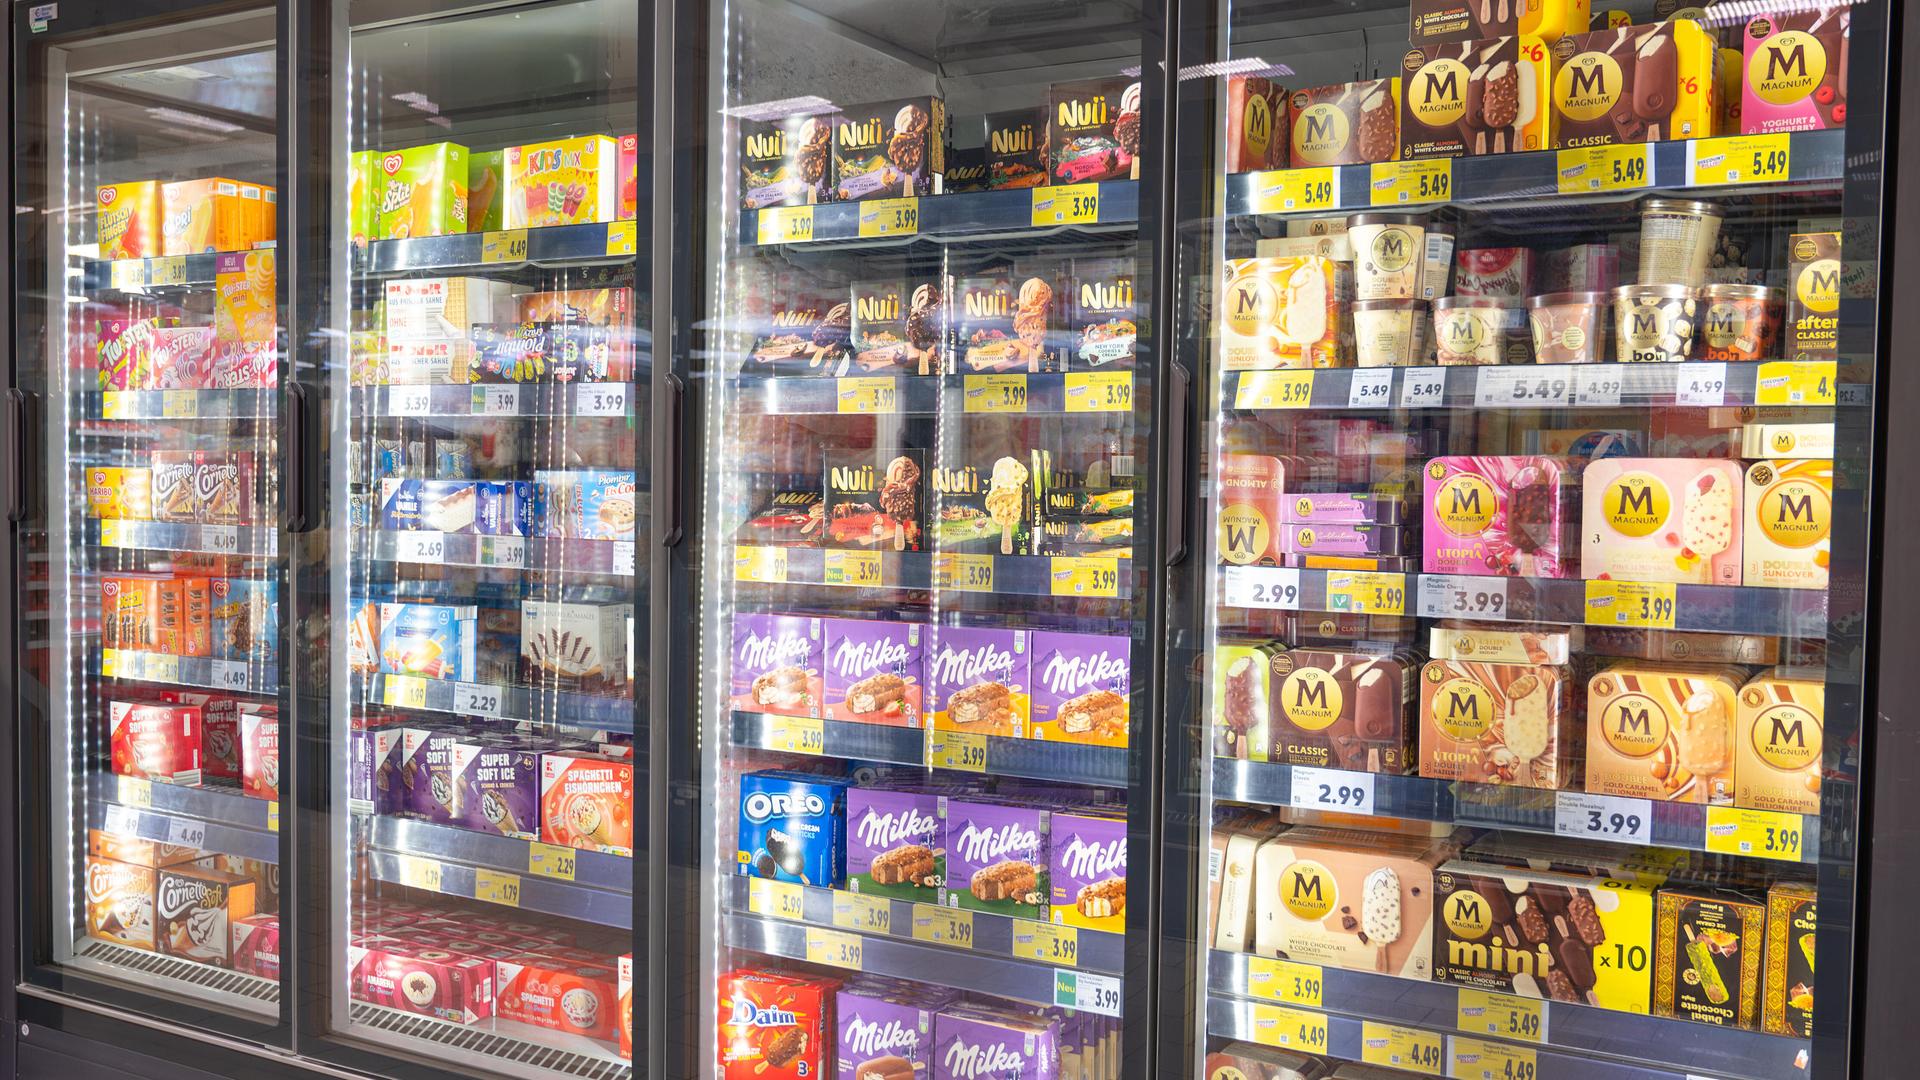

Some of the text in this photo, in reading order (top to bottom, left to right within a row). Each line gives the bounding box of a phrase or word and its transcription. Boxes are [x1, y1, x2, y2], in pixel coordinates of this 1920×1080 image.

[1441, 12, 1469, 20] CHOCOLATE
[1761, 78, 1813, 91] MAGNUM
[1420, 102, 1463, 113] MAGNUM
[1564, 96, 1610, 108] MAGNUM
[1058, 96, 1108, 127] Nuii
[1762, 118, 1806, 127] YOGHURT
[1762, 123, 1815, 132] RASPBERRY
[1301, 143, 1339, 152] MAGNUM
[1568, 135, 1611, 147] CLASSIC
[529, 149, 581, 175] KIDS MIX
[1613, 157, 1644, 183] 5.49
[1753, 151, 1786, 175] 5.49
[1305, 182, 1330, 204] 5.49
[1420, 173, 1448, 197] 5.49
[1073, 196, 1096, 216] 3.99
[792, 217, 811, 236] 3.99
[896, 209, 916, 229] 3.99
[510, 240, 526, 256] 4.49
[172, 263, 185, 280] 3.89
[232, 293, 248, 304] mini
[1082, 280, 1133, 309] Nuii
[858, 294, 899, 322] Nuii
[966, 289, 1006, 317] Nuii
[1796, 317, 1838, 330] after
[1796, 332, 1835, 340] CLASSIC
[1106, 384, 1130, 404] 3.99
[1282, 384, 1310, 402] 3.99
[1361, 385, 1388, 397] 5.49
[1413, 384, 1441, 396] 5.49
[1513, 380, 1566, 399] 5.49
[1588, 381, 1620, 395] 4.99
[1690, 380, 1722, 393] 4.99
[404, 396, 428, 410] 3.39
[498, 394, 513, 410] 3.99
[594, 395, 623, 410] 3.99
[874, 389, 894, 407] 3.99
[1003, 386, 1025, 405] 3.99
[196, 464, 238, 500] Cornetto
[831, 465, 874, 492] Nuii
[1226, 479, 1266, 488] ALMOND
[90, 486, 112, 496] HARIBO
[1614, 516, 1658, 524] MAGNUM
[1774, 524, 1818, 532] MAGNUM
[214, 535, 235, 549] 4.49
[417, 542, 442, 556] 2.69
[506, 546, 523, 562] 3.99
[1437, 544, 1482, 560] UTOPIA
[827, 569, 843, 581] Neu
[860, 562, 880, 581] 3.99
[969, 568, 990, 586] 3.99
[1763, 570, 1813, 578] SUNLOVER
[1092, 570, 1116, 590] 3.99
[1252, 584, 1297, 604] 2.99
[1375, 588, 1402, 609] 3.99
[1454, 591, 1504, 612] 3.99
[1640, 598, 1672, 621] 3.99
[740, 630, 812, 670] Milka
[833, 636, 909, 678] Milka
[936, 643, 1015, 685] Milka
[224, 670, 245, 685] 4.49
[1043, 650, 1129, 695] Milka
[410, 686, 423, 702] 1.99
[209, 700, 233, 711] SUPER
[470, 695, 496, 711] 2.29
[206, 711, 237, 724] SOFT ICE
[1292, 708, 1332, 717] MAGNUM
[1444, 719, 1482, 728] MAGNUM
[259, 736, 274, 748] SOFT
[802, 730, 822, 749] 3.99
[1613, 734, 1655, 744] MAGNUM
[426, 751, 447, 763] SOFT
[963, 746, 984, 766] 3.99
[1288, 745, 1328, 756] CLASSIC
[1765, 746, 1809, 756] MAGNUM
[481, 754, 510, 766] SUPER
[523, 758, 533, 766] 4x
[477, 768, 515, 780] SOFT ICE
[568, 768, 613, 781] SPAGHETTI
[564, 781, 622, 793] EISHÖRNCHEN
[1318, 784, 1364, 806] 2.99
[1603, 788, 1647, 797] BILLIONAIRE
[1622, 783, 1659, 792] CARAMEL
[1559, 794, 1583, 802] Magnum
[1776, 798, 1815, 807] CARAMEL
[745, 794, 824, 819] OREO
[1754, 802, 1802, 812] BILLIONAIRE
[858, 808, 938, 848] Milka
[1587, 811, 1641, 835] 3.99
[181, 828, 203, 844] 4.49
[957, 823, 1040, 864] Milka
[1766, 828, 1798, 852] 3.99
[557, 858, 574, 874] 2.29
[425, 870, 438, 884] 1.79
[158, 875, 223, 920] Cornetto Soft
[502, 883, 518, 901] 1.79
[782, 894, 802, 913] 3.99
[1289, 900, 1326, 910] MAGNUM
[868, 908, 888, 928] 3.99
[950, 921, 971, 942] 3.99
[1052, 938, 1075, 959] 3.99
[1289, 938, 1346, 952] WHITE CHOCOLATE
[1295, 945, 1320, 953] COOKIES
[841, 944, 860, 963] 3.99
[1447, 936, 1549, 978] mini
[1600, 944, 1646, 971] x10
[1057, 982, 1076, 993] Neu
[1294, 978, 1320, 999] 3.99
[1474, 977, 1506, 986] CHOCOLATE
[520, 991, 554, 1007] SPAGHETTI
[1095, 988, 1118, 1010] 3.99
[731, 998, 796, 1026] Daim
[1681, 1002, 1733, 1018] Chocolate
[1509, 1012, 1539, 1036] 5.49
[1692, 1012, 1722, 1025] Dubai
[845, 1020, 919, 1056] Milka
[1299, 1024, 1324, 1046] 4.49
[945, 1038, 1024, 1080] Milka
[1411, 1044, 1439, 1066] 4.49
